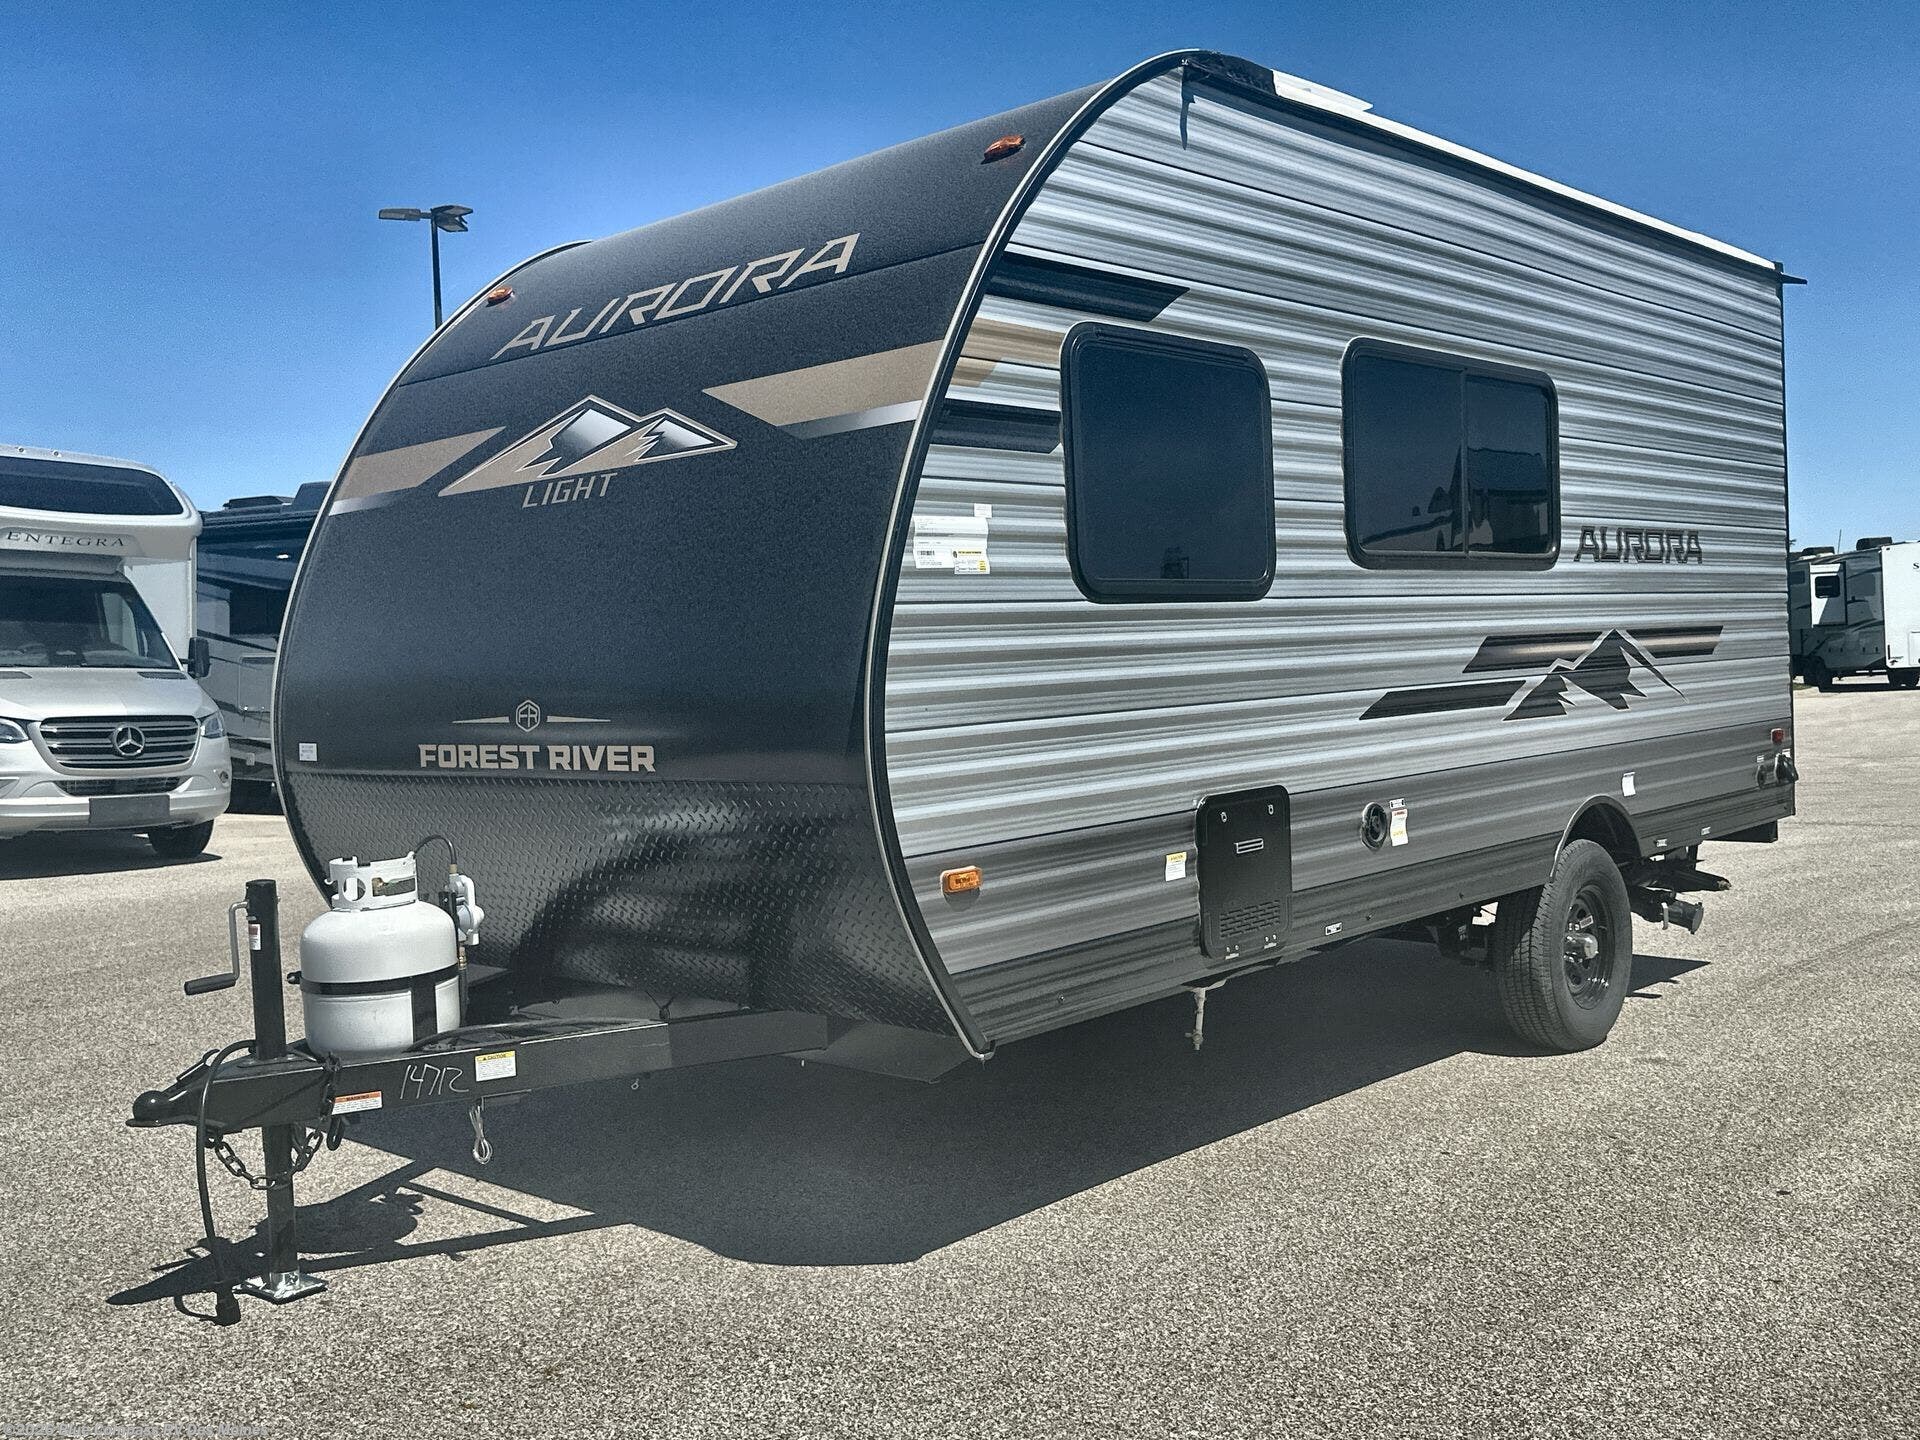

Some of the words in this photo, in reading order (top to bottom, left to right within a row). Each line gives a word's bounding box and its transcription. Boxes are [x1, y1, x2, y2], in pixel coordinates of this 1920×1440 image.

[490, 232, 861, 361] AURORA
[521, 472, 618, 509] LIGHT
[6, 531, 125, 547] ENTEGRA
[1573, 525, 1703, 564] AURORA
[418, 744, 540, 770] FOREST
[547, 745, 656, 772] RIVER
